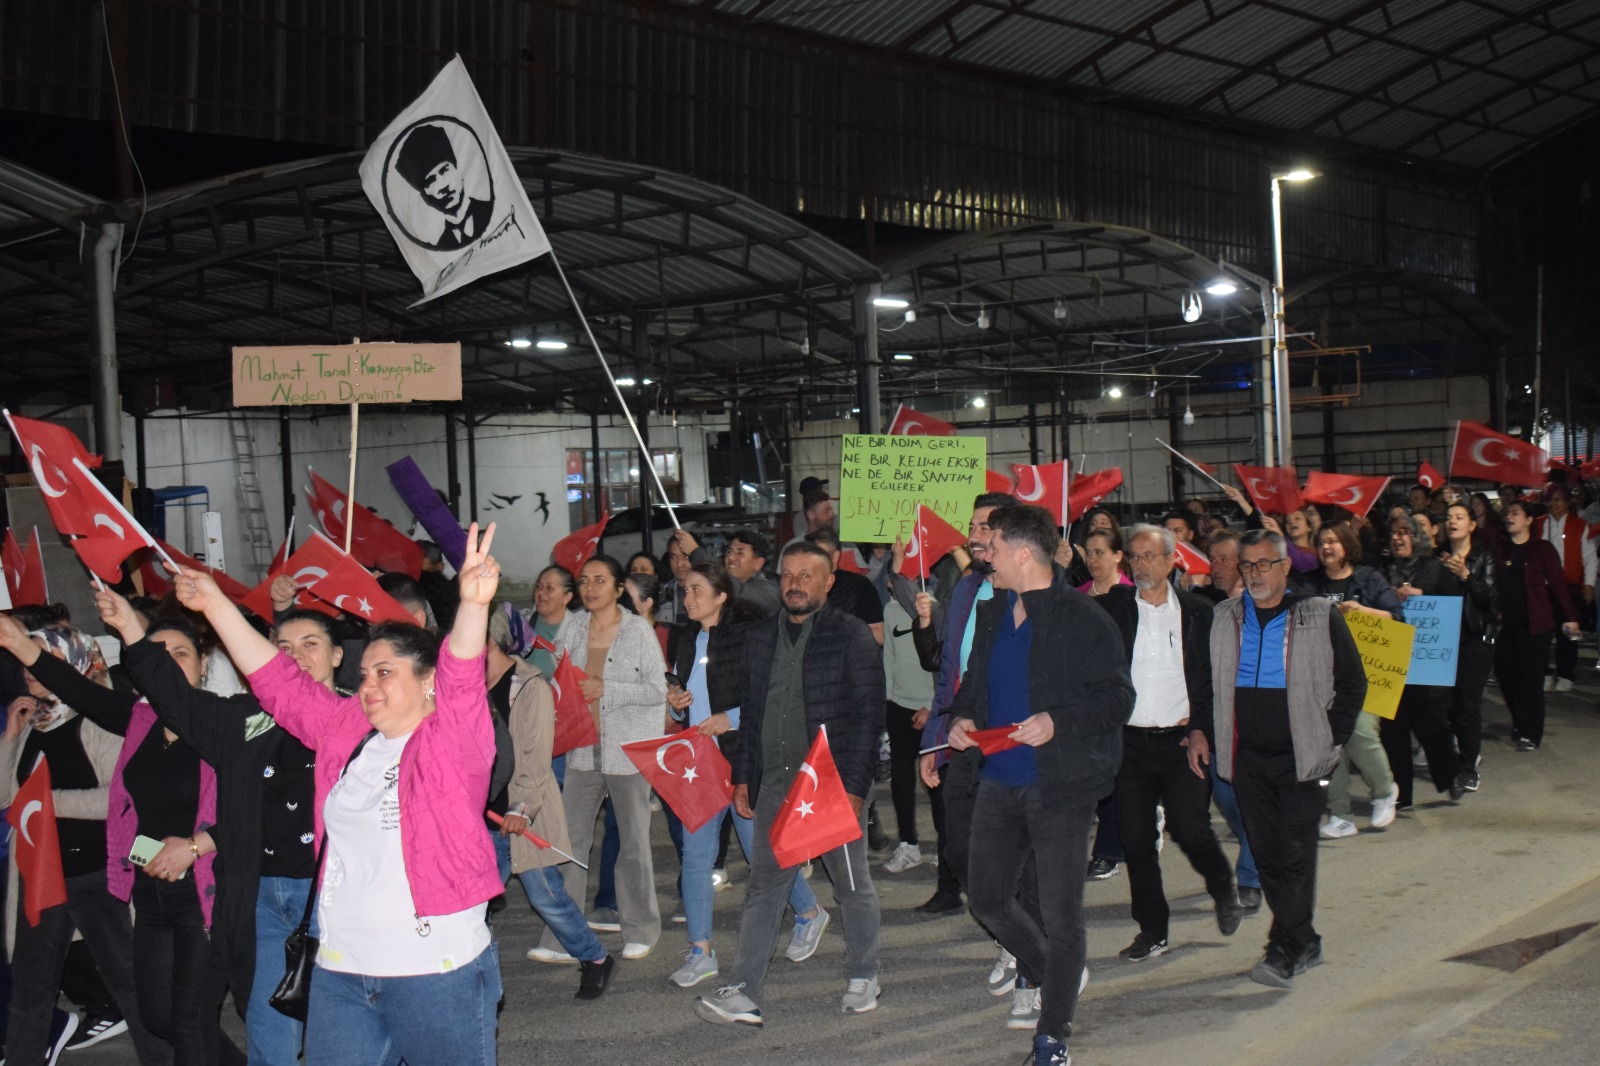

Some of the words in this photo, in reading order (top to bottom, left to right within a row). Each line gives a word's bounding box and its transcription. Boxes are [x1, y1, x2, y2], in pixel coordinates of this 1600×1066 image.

[240, 355, 306, 384] Mahmut
[311, 354, 351, 379] Tanal
[271, 381, 327, 404] Neden
[844, 436, 863, 449] NE
[890, 437, 923, 449] ADIM
[843, 453, 861, 464] NE
[842, 467, 861, 478] NE
[867, 468, 882, 479] DE
[845, 495, 881, 519] SEN
[1404, 599, 1437, 612] ELEN
[1345, 612, 1382, 630] URADA
